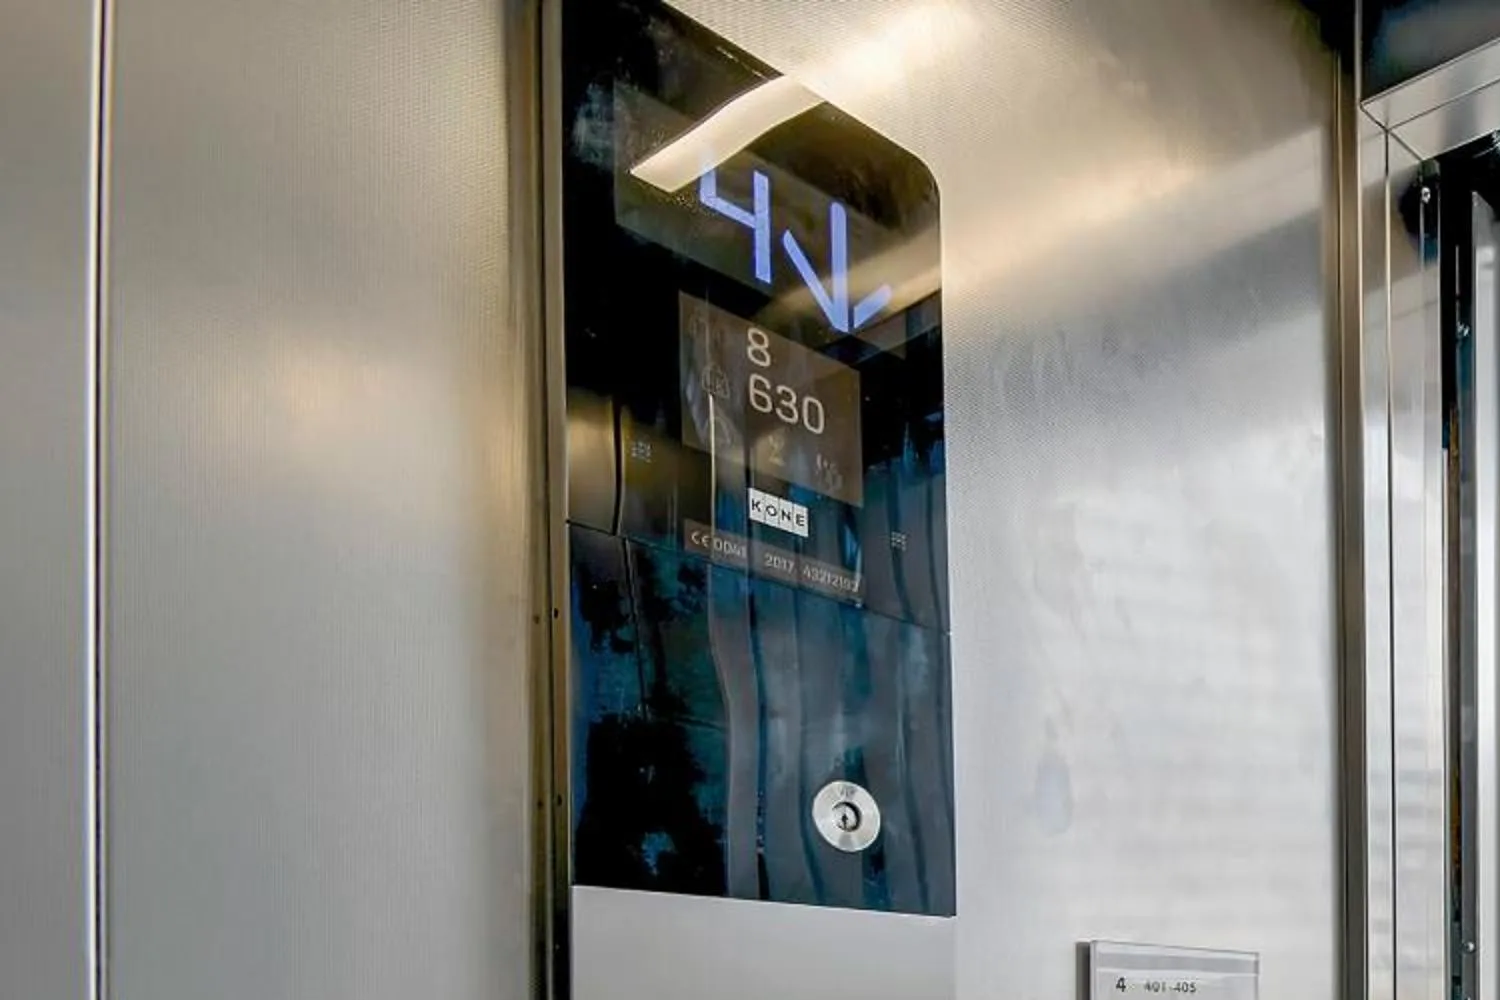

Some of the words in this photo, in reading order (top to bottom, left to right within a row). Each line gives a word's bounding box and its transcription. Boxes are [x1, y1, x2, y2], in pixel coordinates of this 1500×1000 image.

[699, 154, 773, 284] 4
[747, 327, 771, 368] 8
[749, 373, 825, 434] 630
[751, 499, 806, 527] KONE
[764, 553, 795, 573] 2017
[1115, 976, 1126, 993] 4
